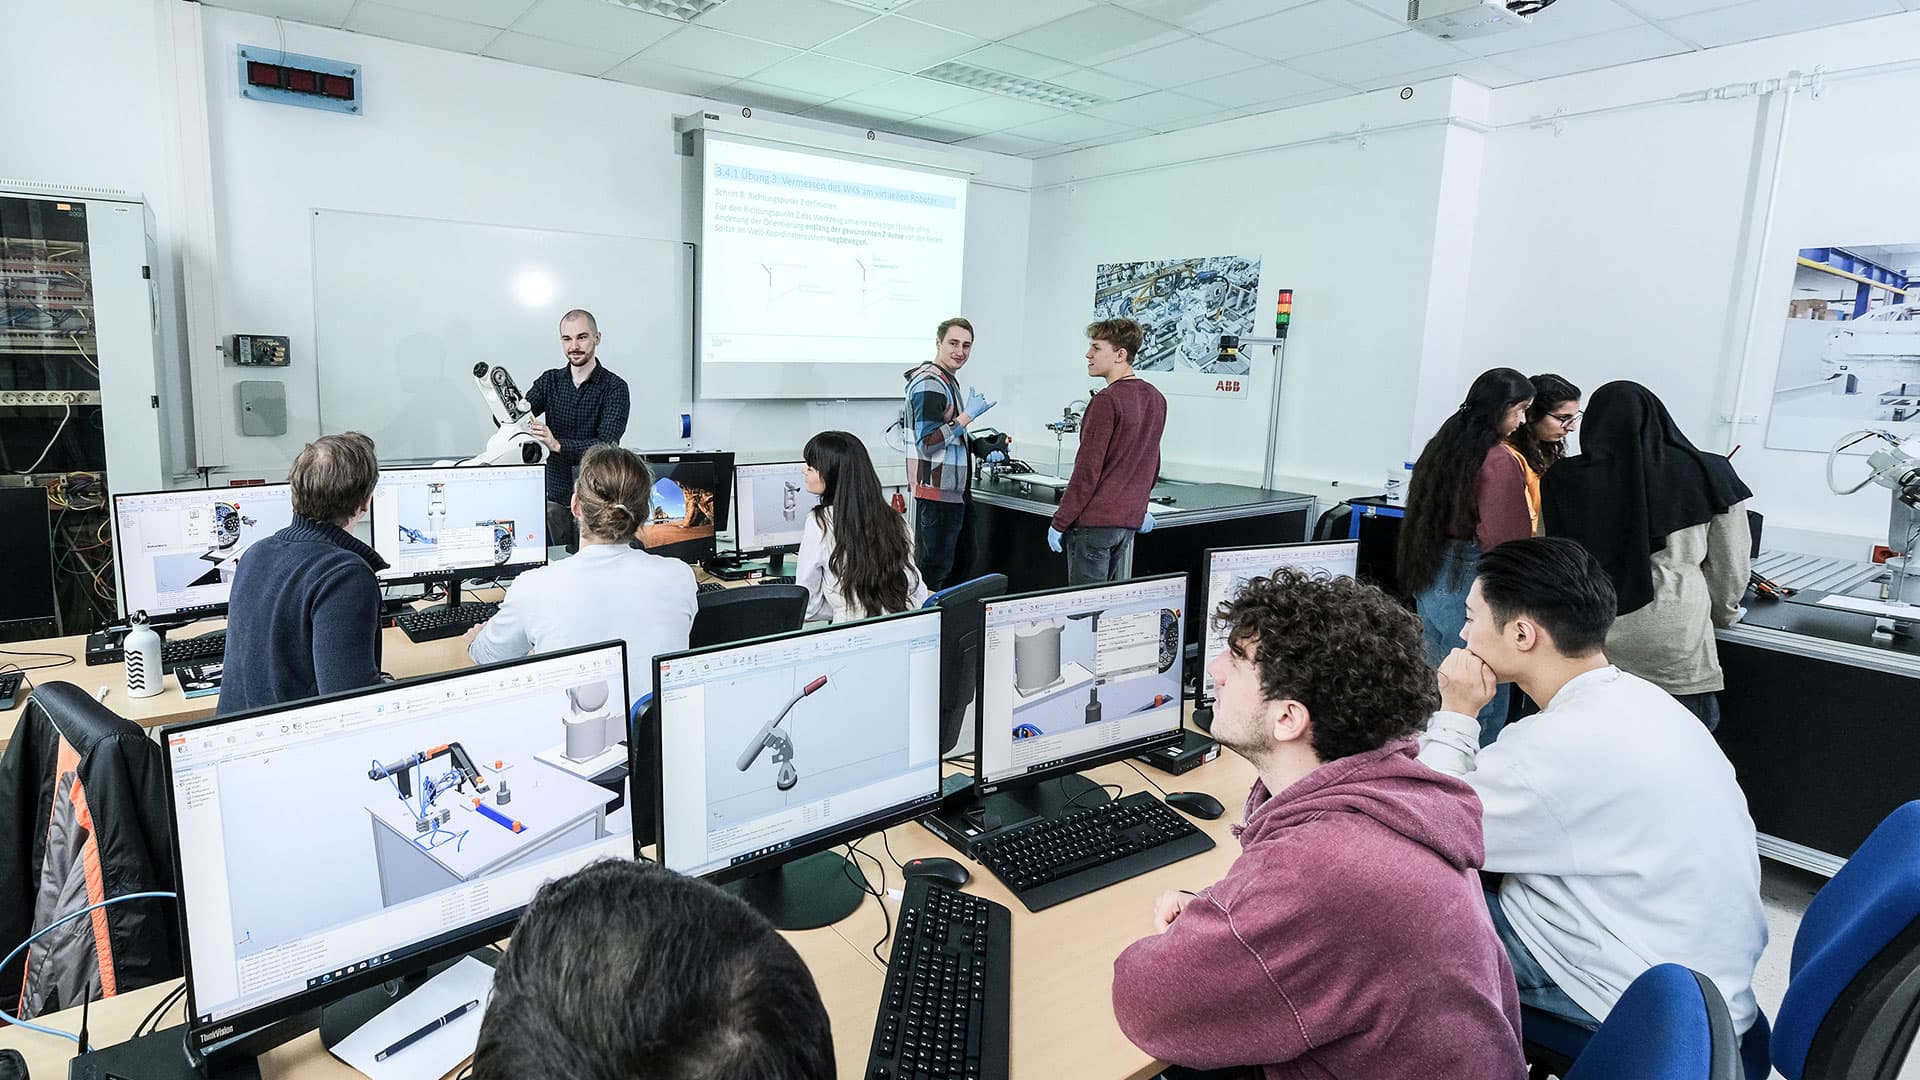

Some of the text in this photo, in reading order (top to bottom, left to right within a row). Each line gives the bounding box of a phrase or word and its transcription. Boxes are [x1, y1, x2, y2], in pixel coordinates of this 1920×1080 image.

[715, 166, 738, 178] 3.4.1
[741, 167, 770, 185] Übung
[782, 175, 826, 191] Vermessen
[828, 183, 841, 192] des
[843, 184, 860, 194] WKS
[875, 189, 909, 200] virtuellen
[750, 216, 762, 224] der
[805, 223, 829, 235] entlang
[831, 225, 841, 233] der
[842, 226, 881, 239] gewünschten
[1215, 380, 1240, 392] ABB
[200, 1025, 233, 1044] ThinkVision
